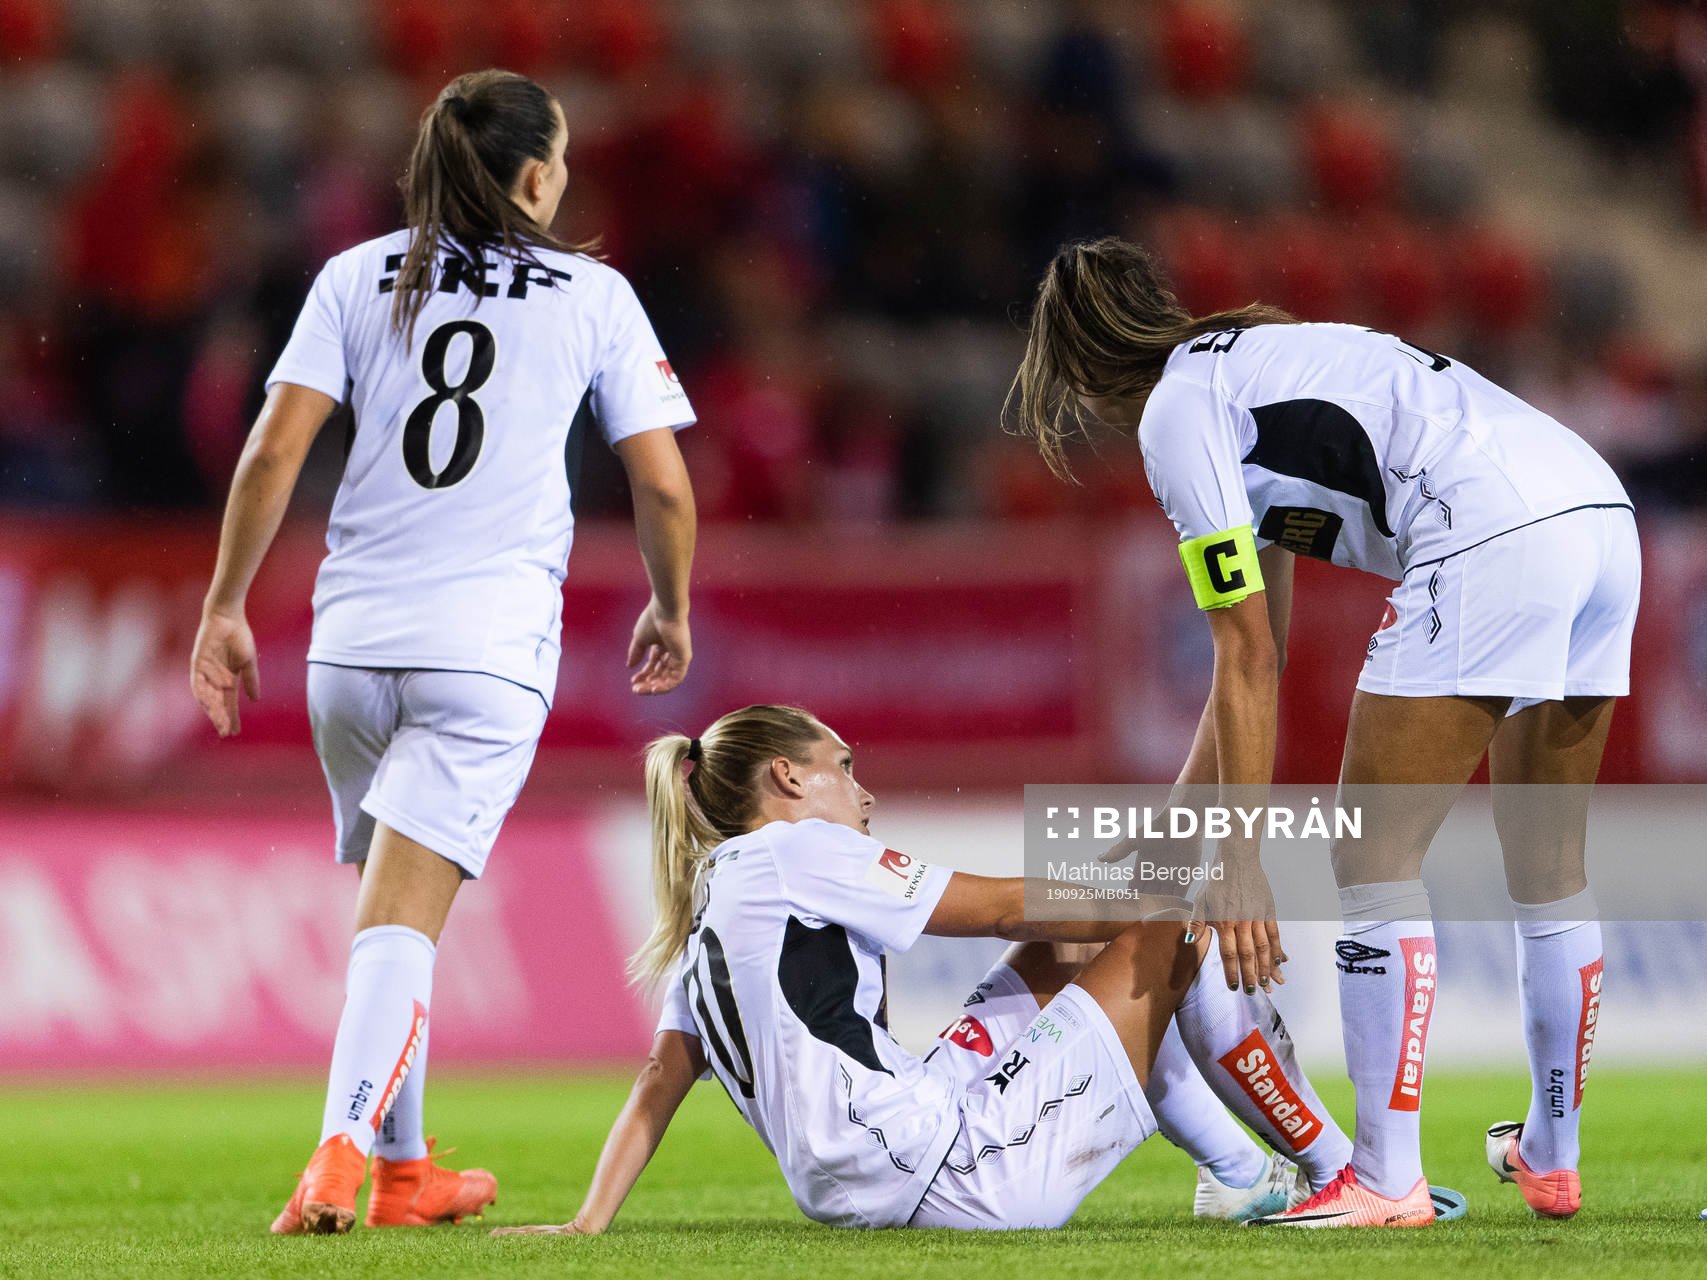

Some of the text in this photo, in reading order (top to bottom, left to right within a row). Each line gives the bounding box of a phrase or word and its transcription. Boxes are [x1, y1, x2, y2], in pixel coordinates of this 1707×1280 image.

[402, 319, 496, 490] 8
[1203, 539, 1247, 594] C
[904, 864, 928, 900] SVENSKA
[1401, 951, 1436, 1097] Stavdal
[347, 1079, 373, 1121] umbro
[1236, 1048, 1314, 1139] Stavdal
[1546, 1069, 1564, 1118] umbro
